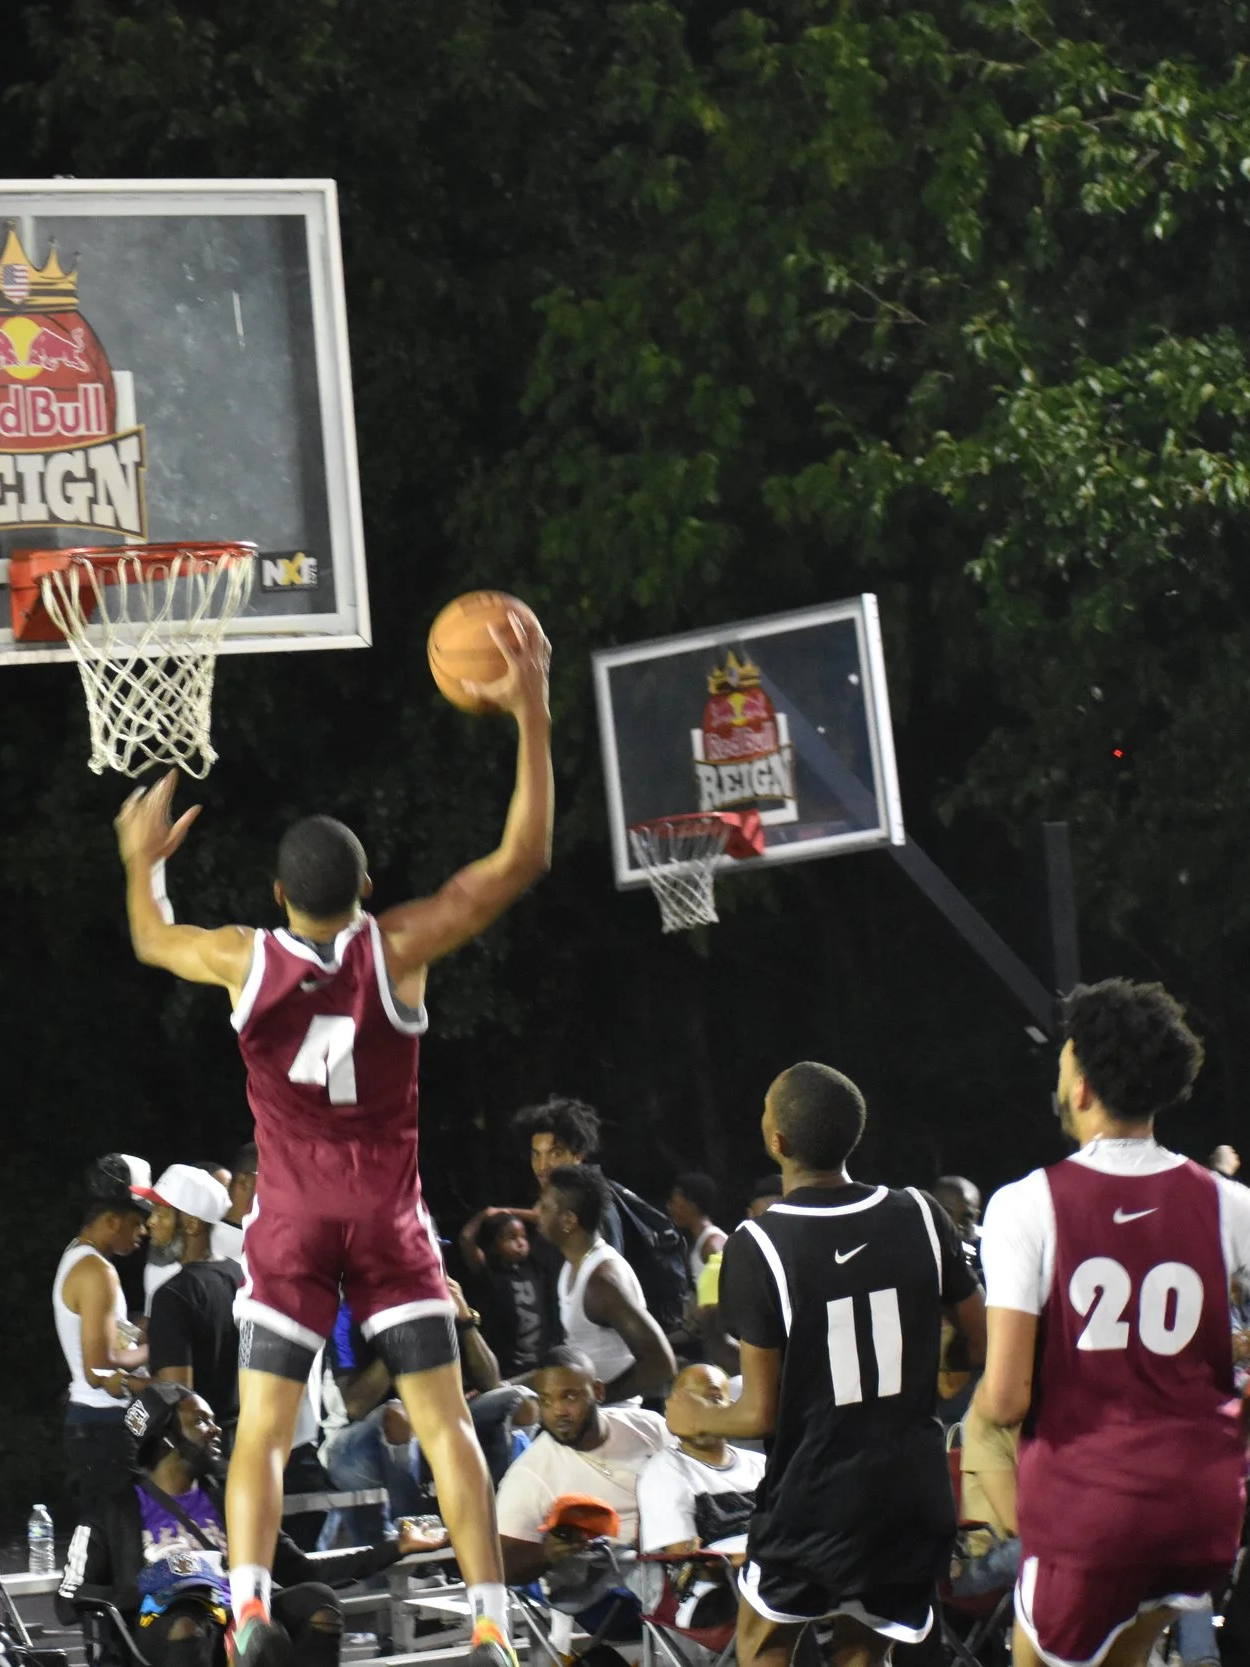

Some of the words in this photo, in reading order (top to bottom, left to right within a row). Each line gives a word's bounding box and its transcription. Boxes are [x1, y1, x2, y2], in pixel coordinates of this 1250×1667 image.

[27, 383, 107, 437] Bull
[262, 551, 318, 587] NXT
[696, 753, 793, 809] REIGN
[288, 1014, 357, 1106] 4
[1069, 1256, 1204, 1356] 20
[827, 1287, 903, 1407] 11
